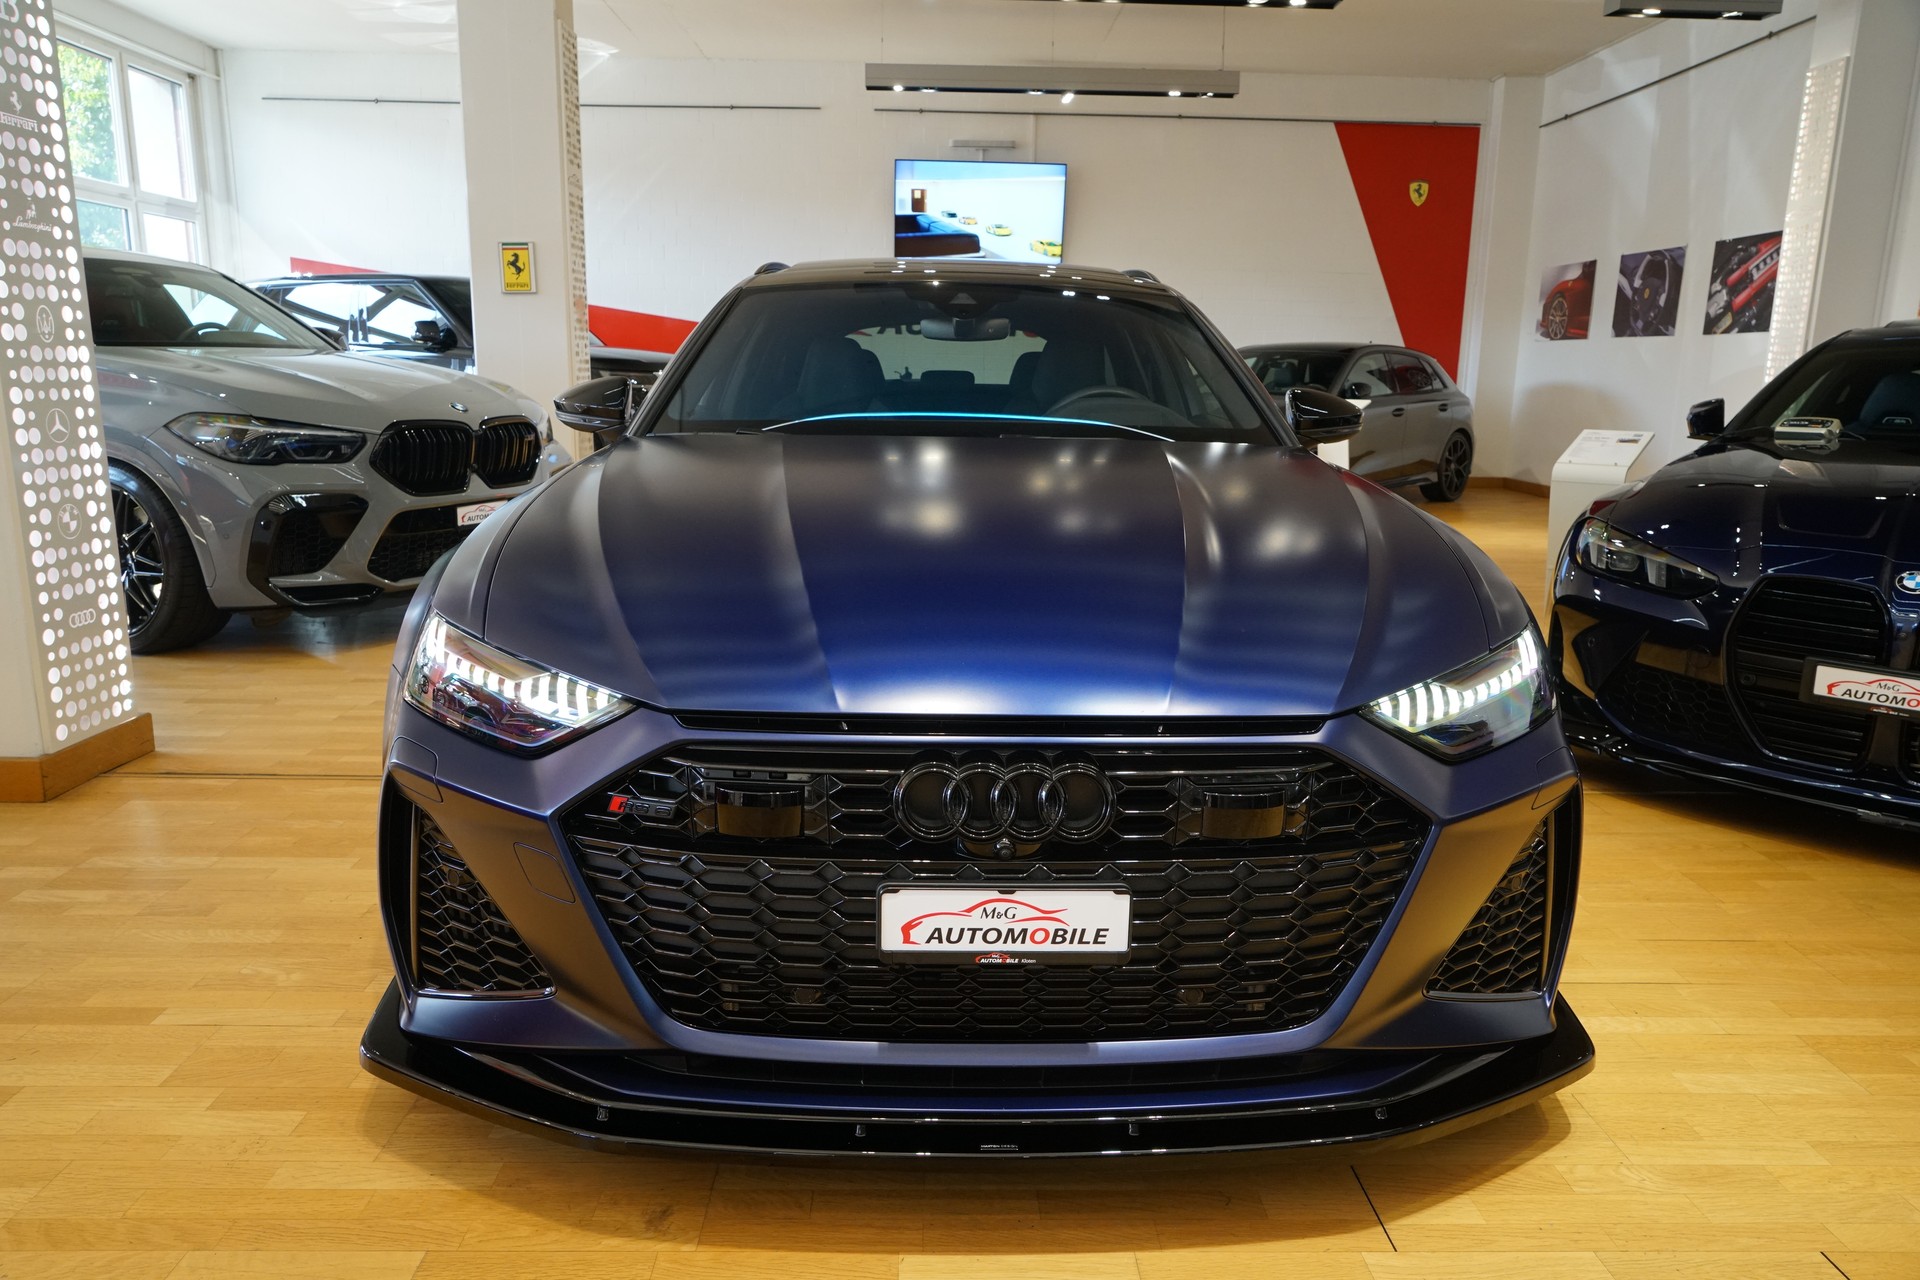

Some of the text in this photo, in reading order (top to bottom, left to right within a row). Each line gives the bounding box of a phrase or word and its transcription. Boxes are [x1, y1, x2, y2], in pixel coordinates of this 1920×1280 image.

[13, 216, 52, 232] Lamborghini
[980, 907, 1017, 920] M&G
[925, 927, 1110, 945] AUTOMOBILE
